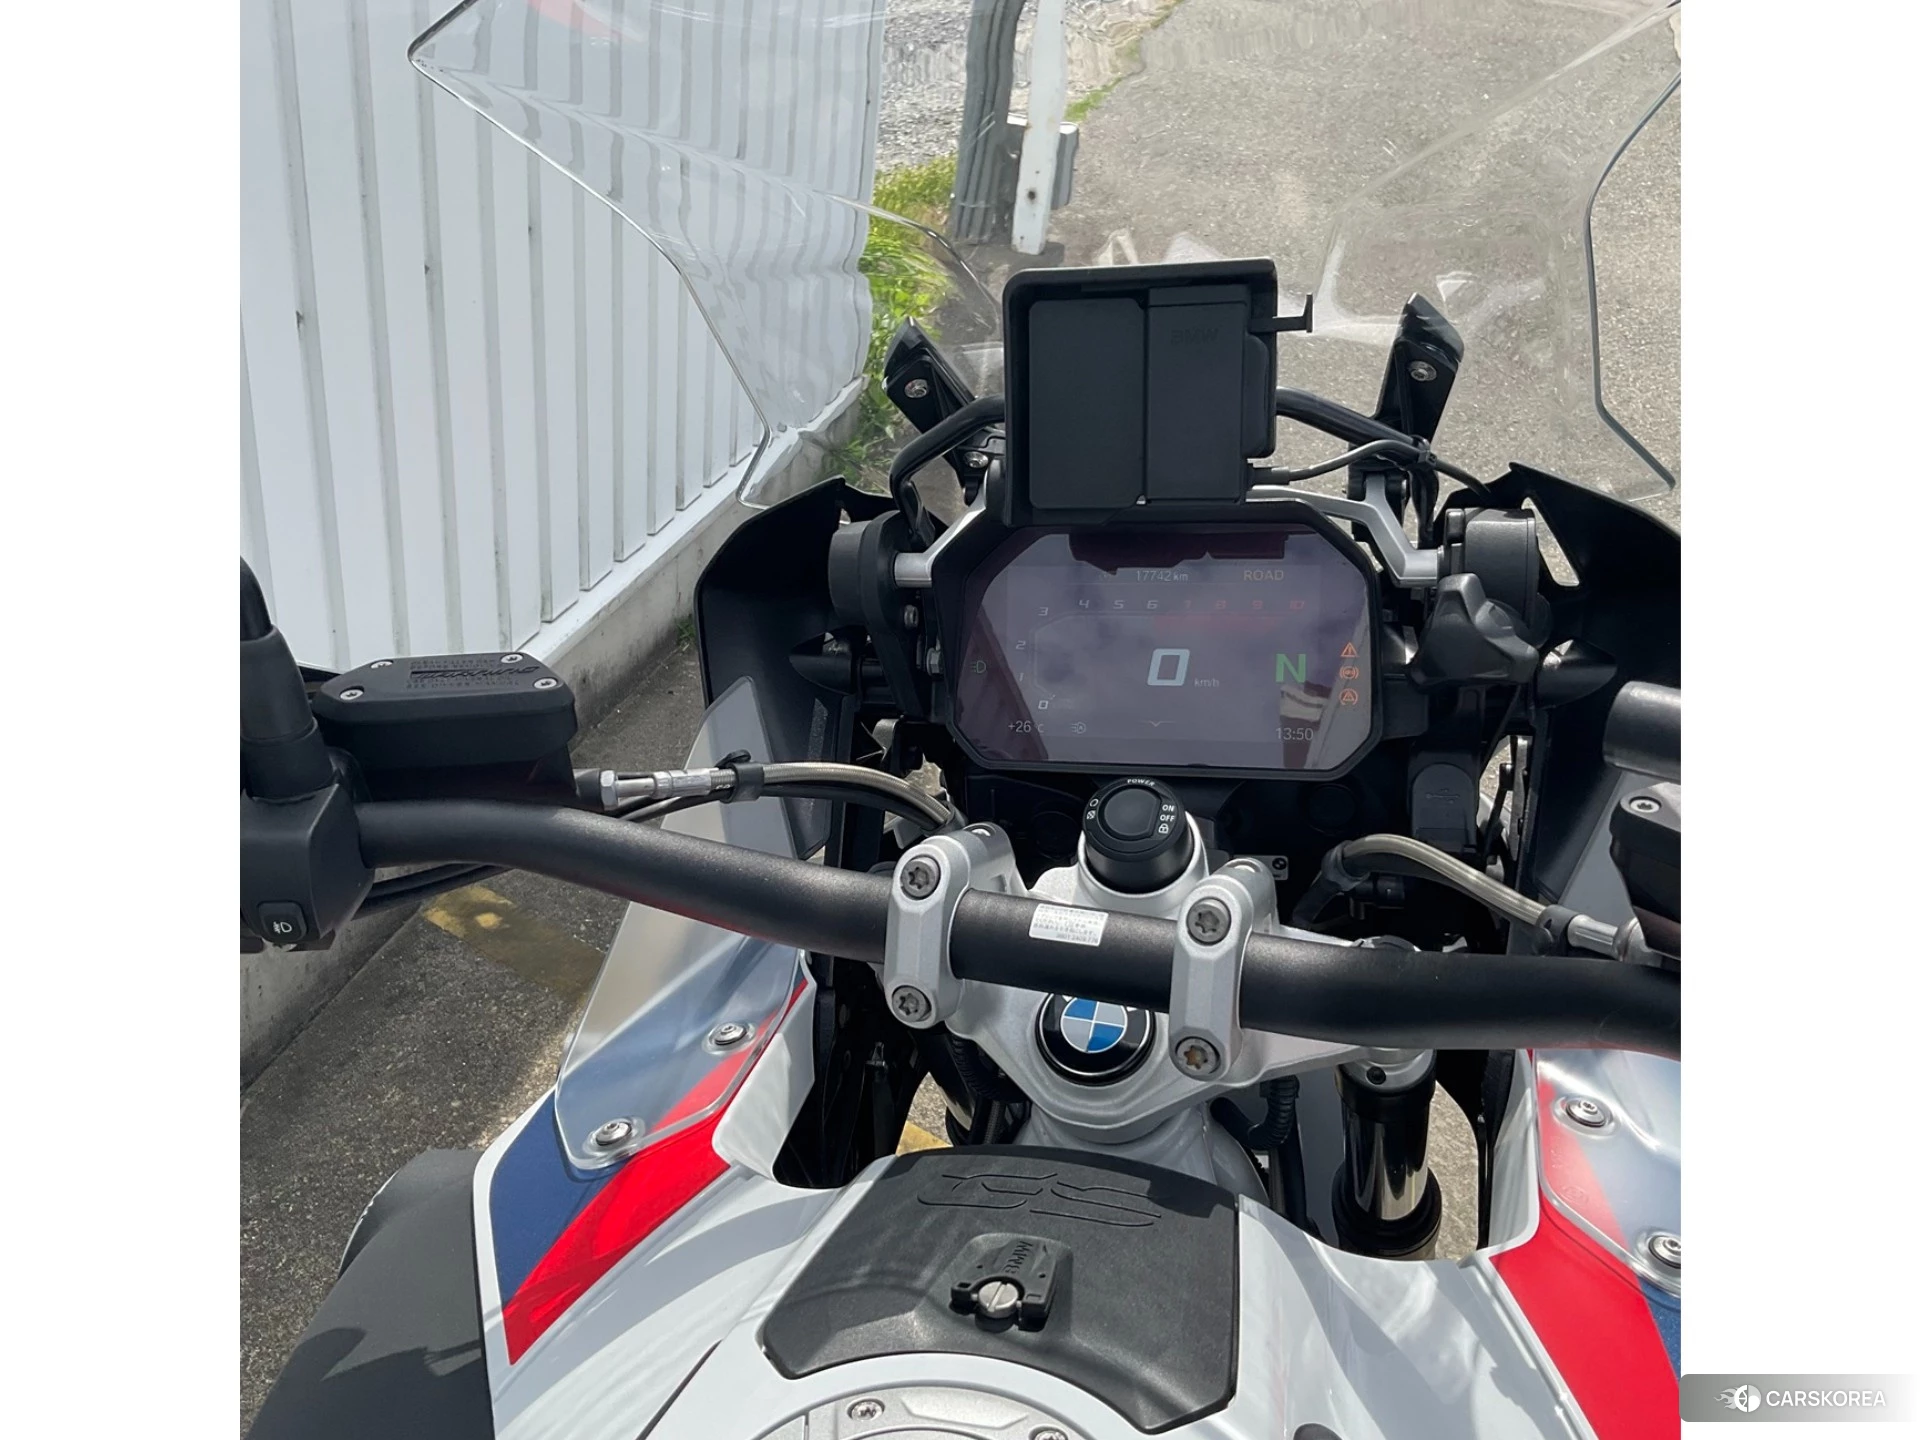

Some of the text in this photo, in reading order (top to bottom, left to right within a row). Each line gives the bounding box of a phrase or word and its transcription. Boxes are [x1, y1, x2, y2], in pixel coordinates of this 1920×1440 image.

[1243, 569, 1285, 582] ROAD
[1078, 599, 1090, 609] 4
[1113, 599, 1126, 609] 5
[1146, 599, 1159, 610] 6
[1037, 606, 1049, 617] 3
[1015, 640, 1026, 650] 2
[1146, 648, 1191, 687] 0
[1275, 653, 1307, 684] N
[1275, 727, 1314, 742] 13:50
[1126, 778, 1156, 787] POWER
[1161, 804, 1175, 812] ON
[1159, 814, 1176, 822] OFF
[917, 1171, 1162, 1228] GS
